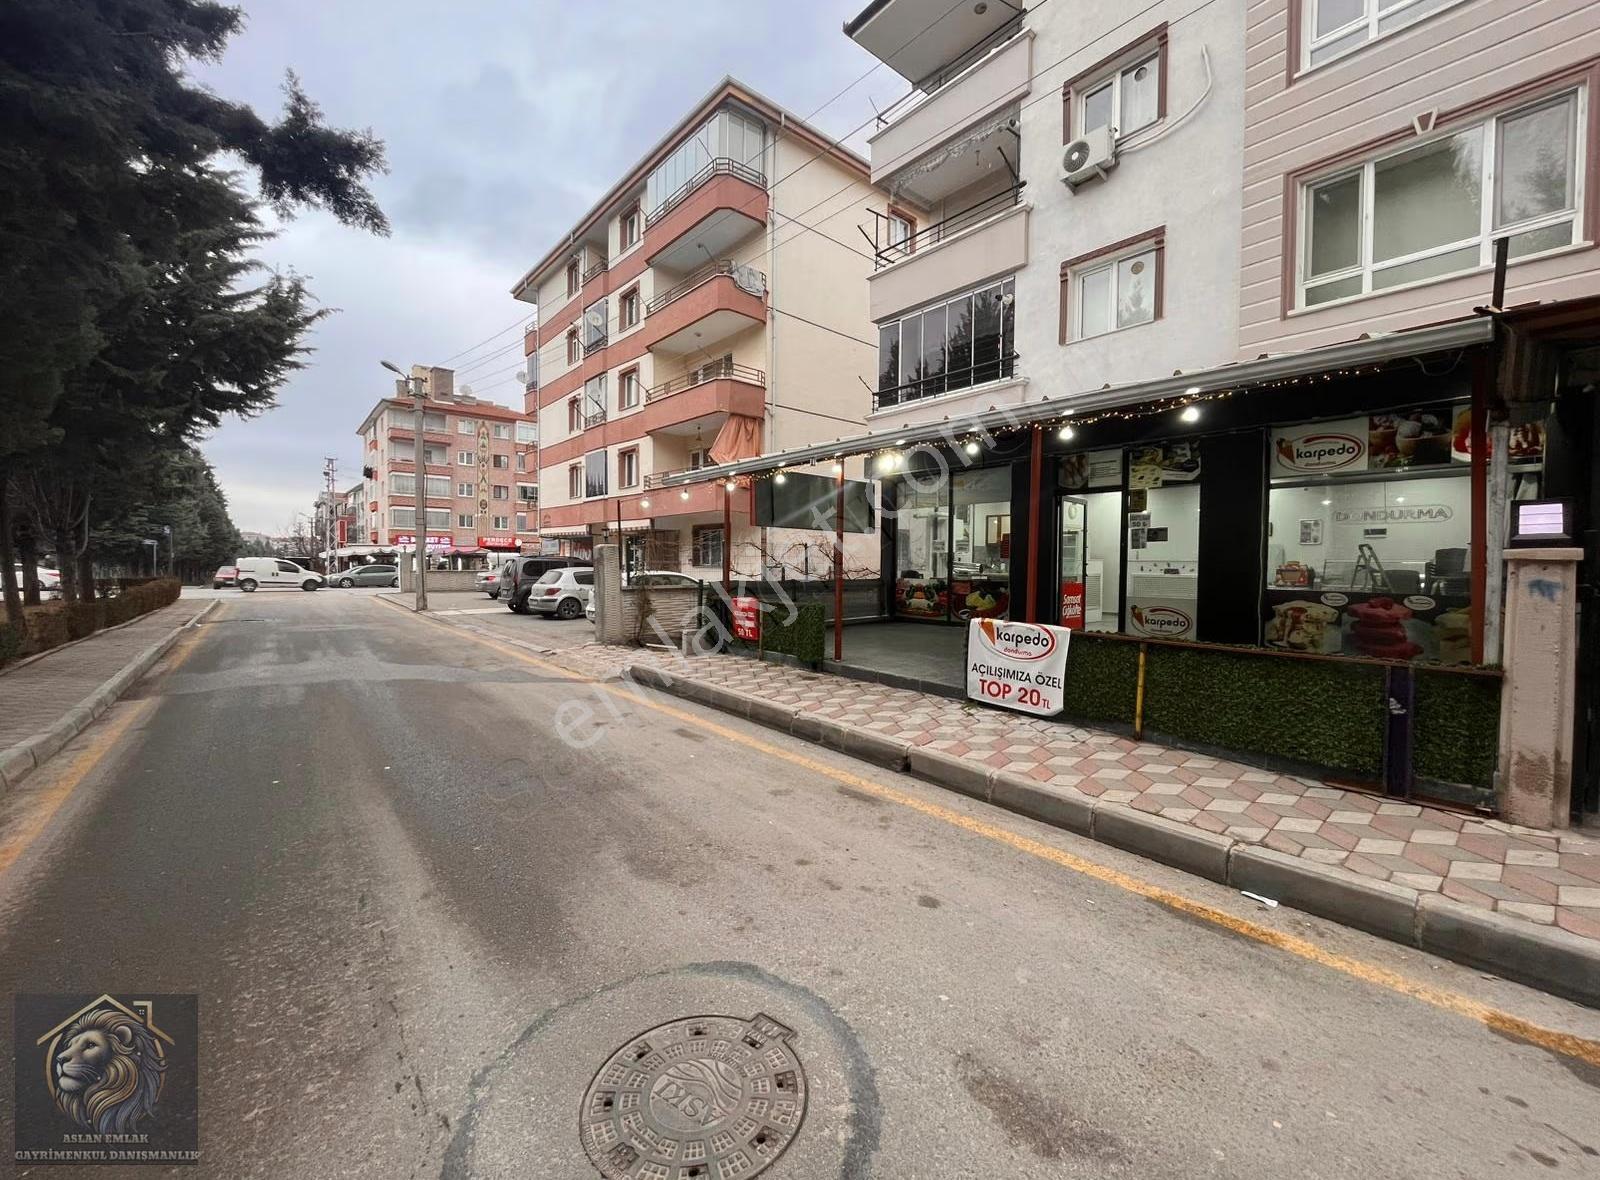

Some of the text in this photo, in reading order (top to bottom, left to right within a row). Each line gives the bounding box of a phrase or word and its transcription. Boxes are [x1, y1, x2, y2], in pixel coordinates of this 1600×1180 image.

[1296, 443, 1355, 461] karpedo
[1144, 616, 1186, 628] karpedo
[996, 627, 1049, 648] karpedo
[971, 663, 1062, 689] AÇILIŞIMIZA ÖZEL
[979, 679, 1051, 709] TOP 20 TL
